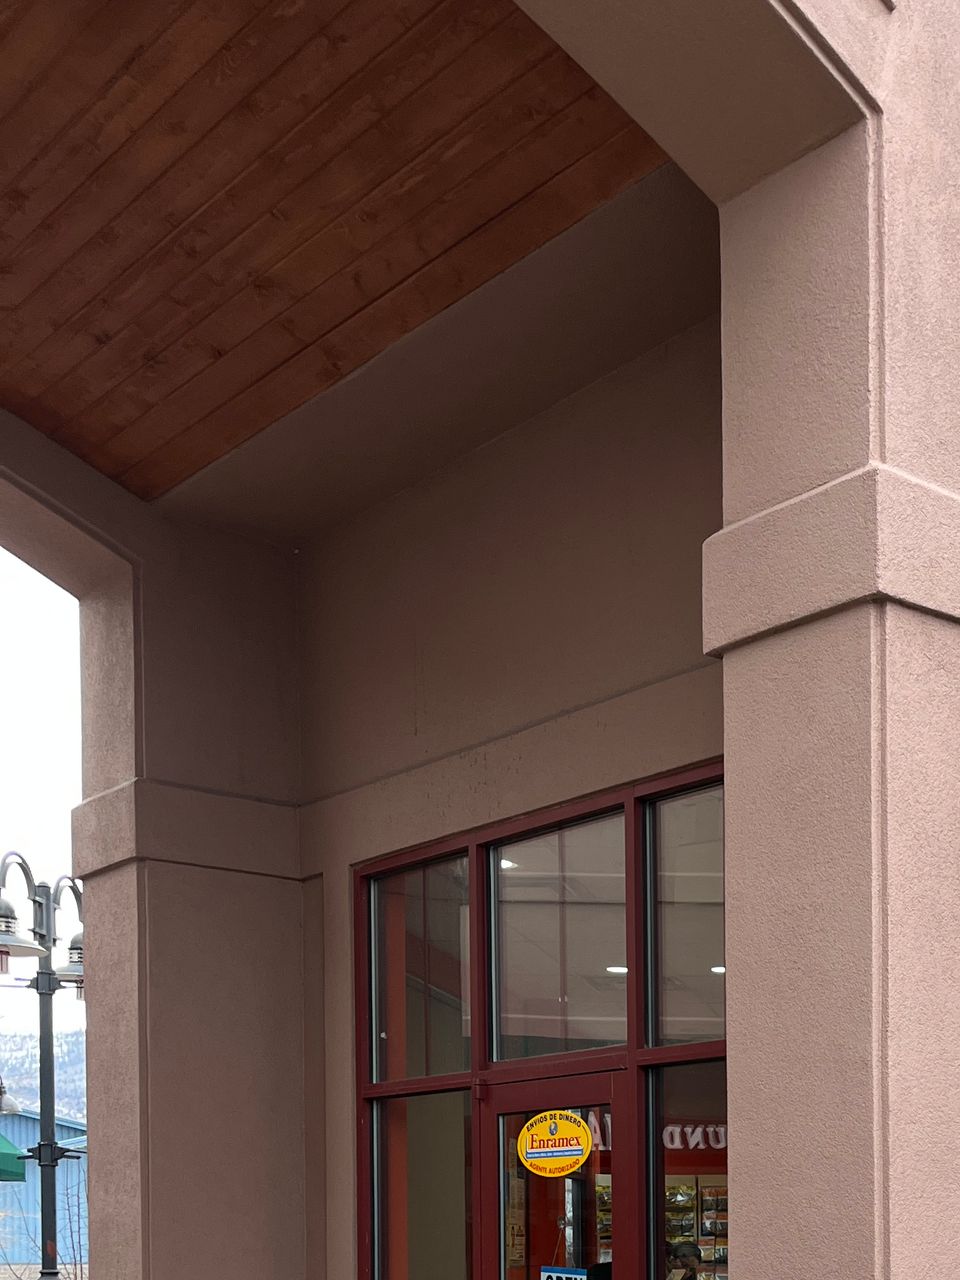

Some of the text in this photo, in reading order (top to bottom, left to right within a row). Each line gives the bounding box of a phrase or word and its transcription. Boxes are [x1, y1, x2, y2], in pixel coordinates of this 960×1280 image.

[526, 1113, 582, 1132] ENVIOS DE DINERO
[529, 1133, 581, 1150] Enramex
